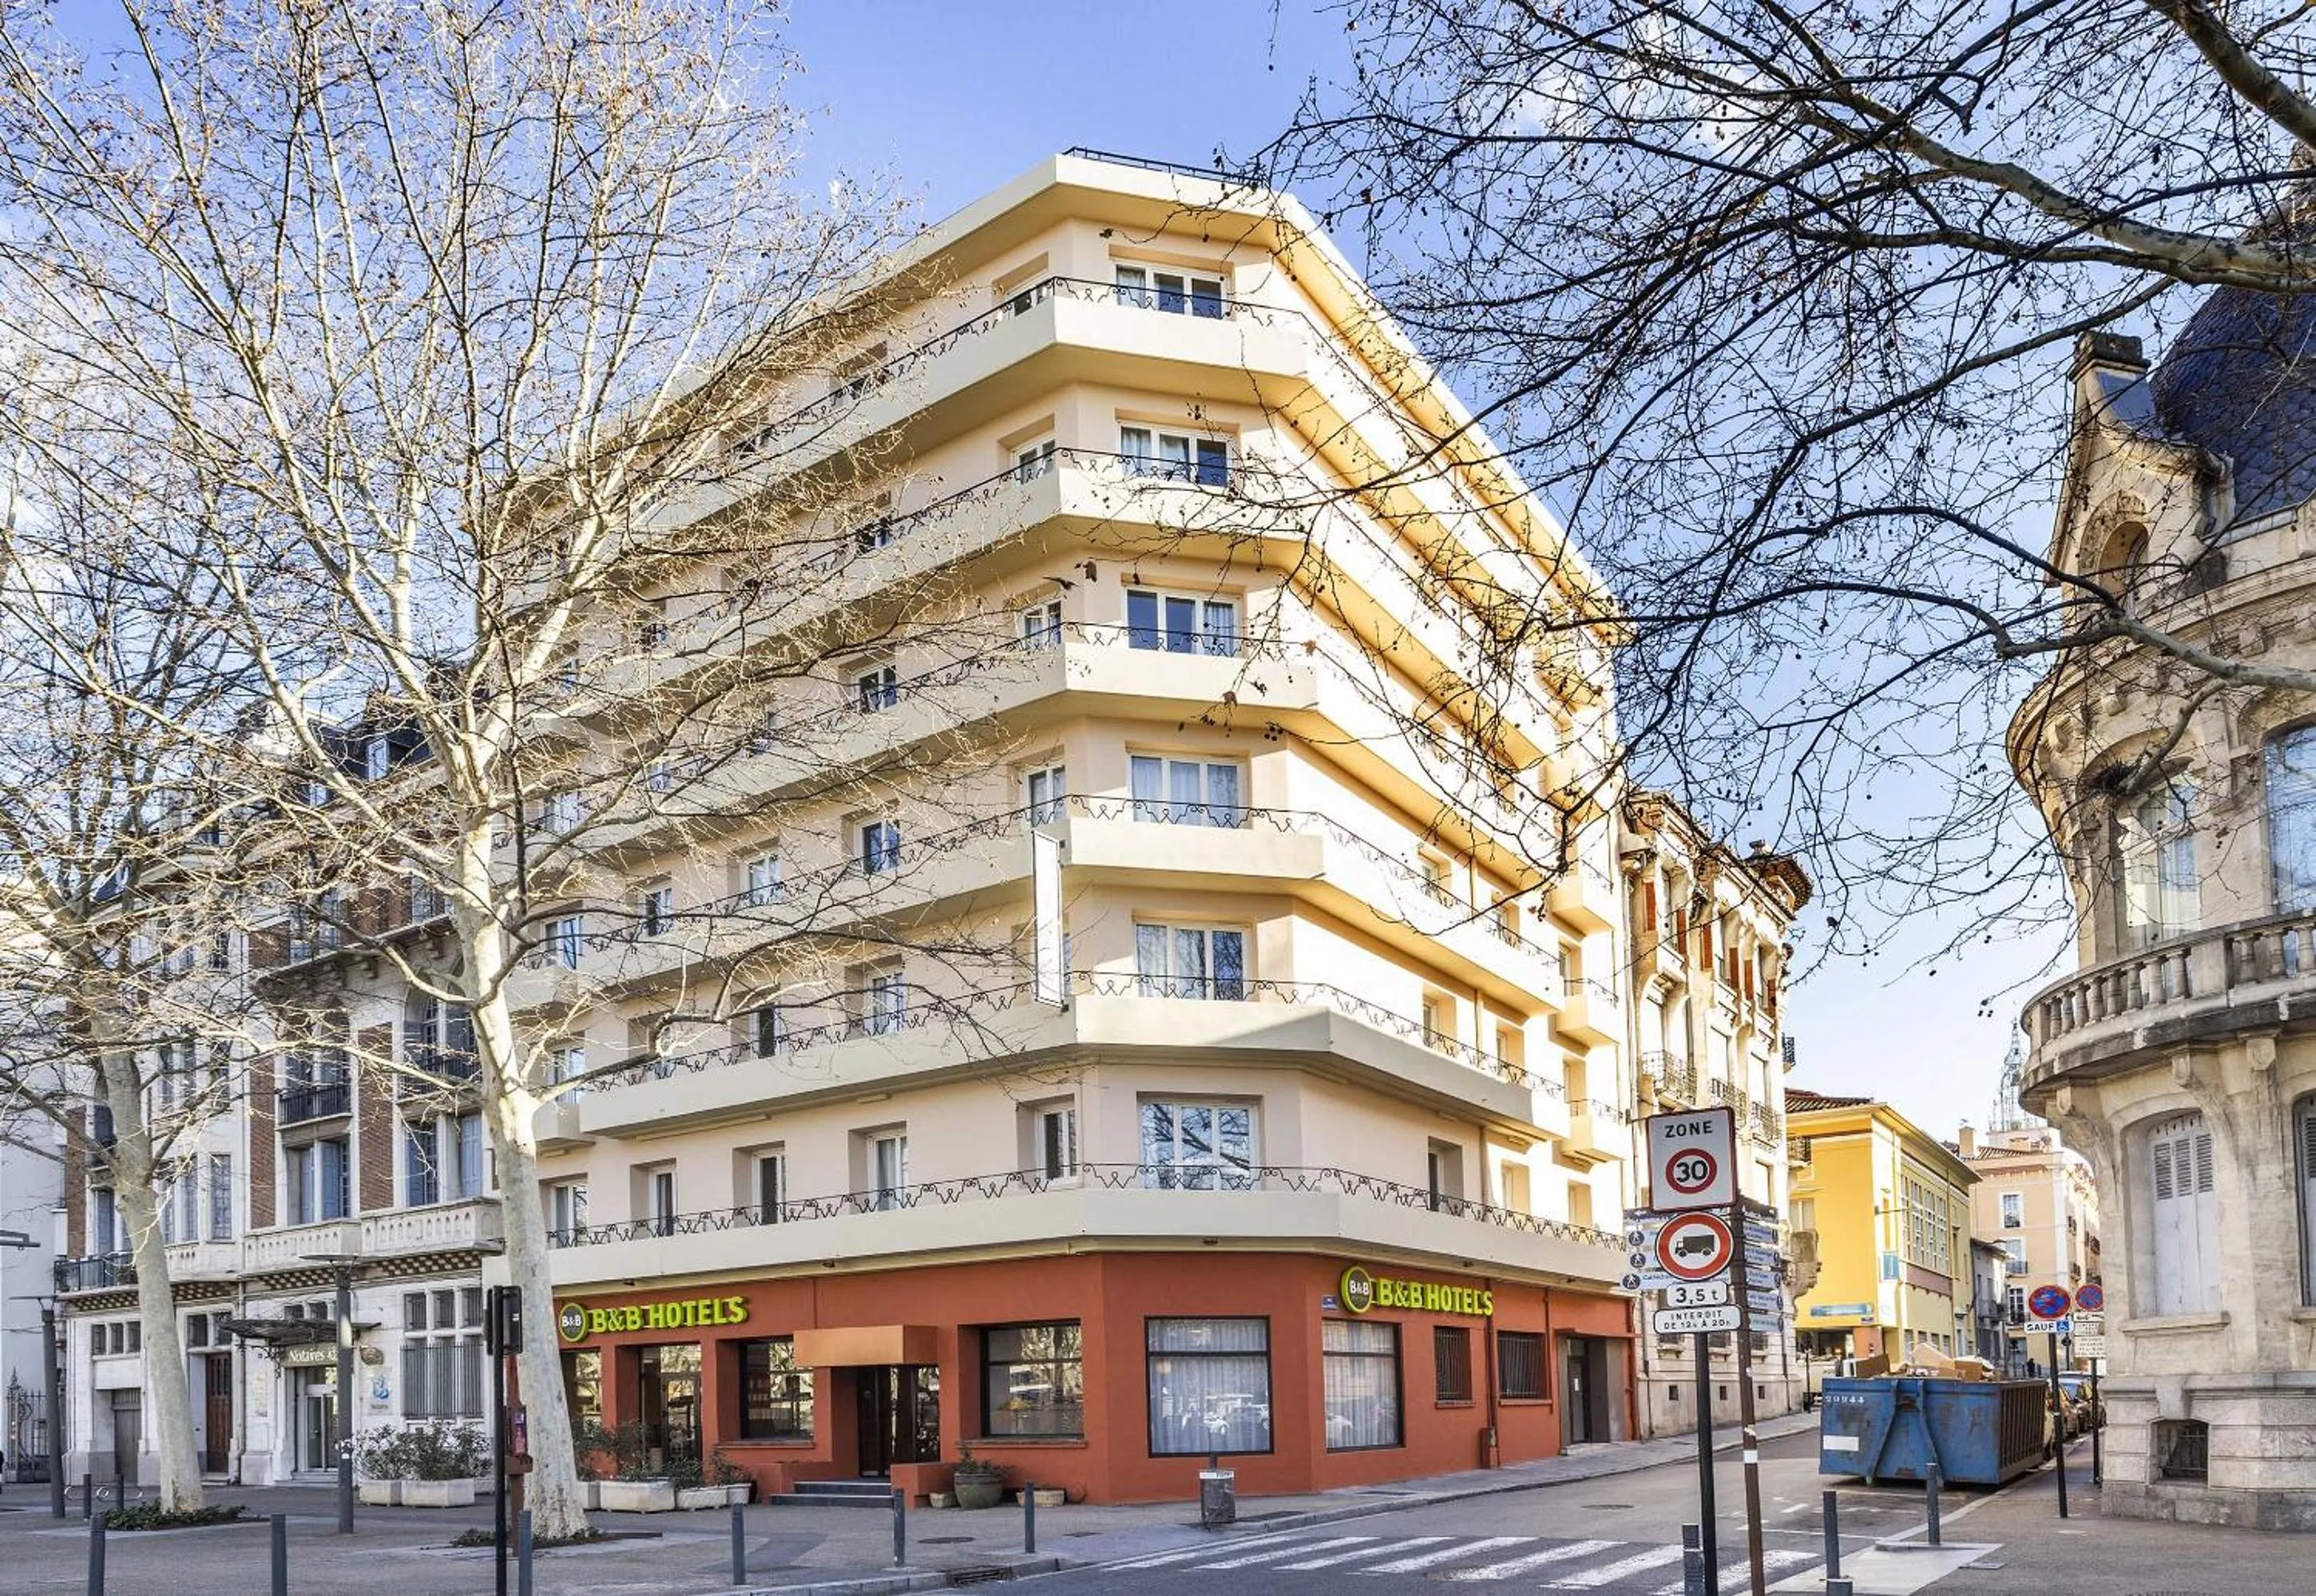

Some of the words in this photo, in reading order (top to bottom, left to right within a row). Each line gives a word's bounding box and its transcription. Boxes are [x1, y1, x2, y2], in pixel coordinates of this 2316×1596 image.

[1664, 1120, 1713, 1139] ZONE
[1676, 1160, 1708, 1182] 30
[1349, 1280, 1370, 1296] B&B
[1378, 1277, 1424, 1308] B&B
[1424, 1283, 1493, 1316] HOTELS
[1676, 1287, 1705, 1305] 3,5
[1711, 1289, 1719, 1301] t
[561, 1314, 582, 1327] B&B
[593, 1305, 644, 1333] B&B
[649, 1296, 748, 1329] HOTELS
[1671, 1310, 1722, 1321] INTERDIT
[2027, 1322, 2055, 1332] SAUF
[289, 1347, 326, 1362] Notaires
